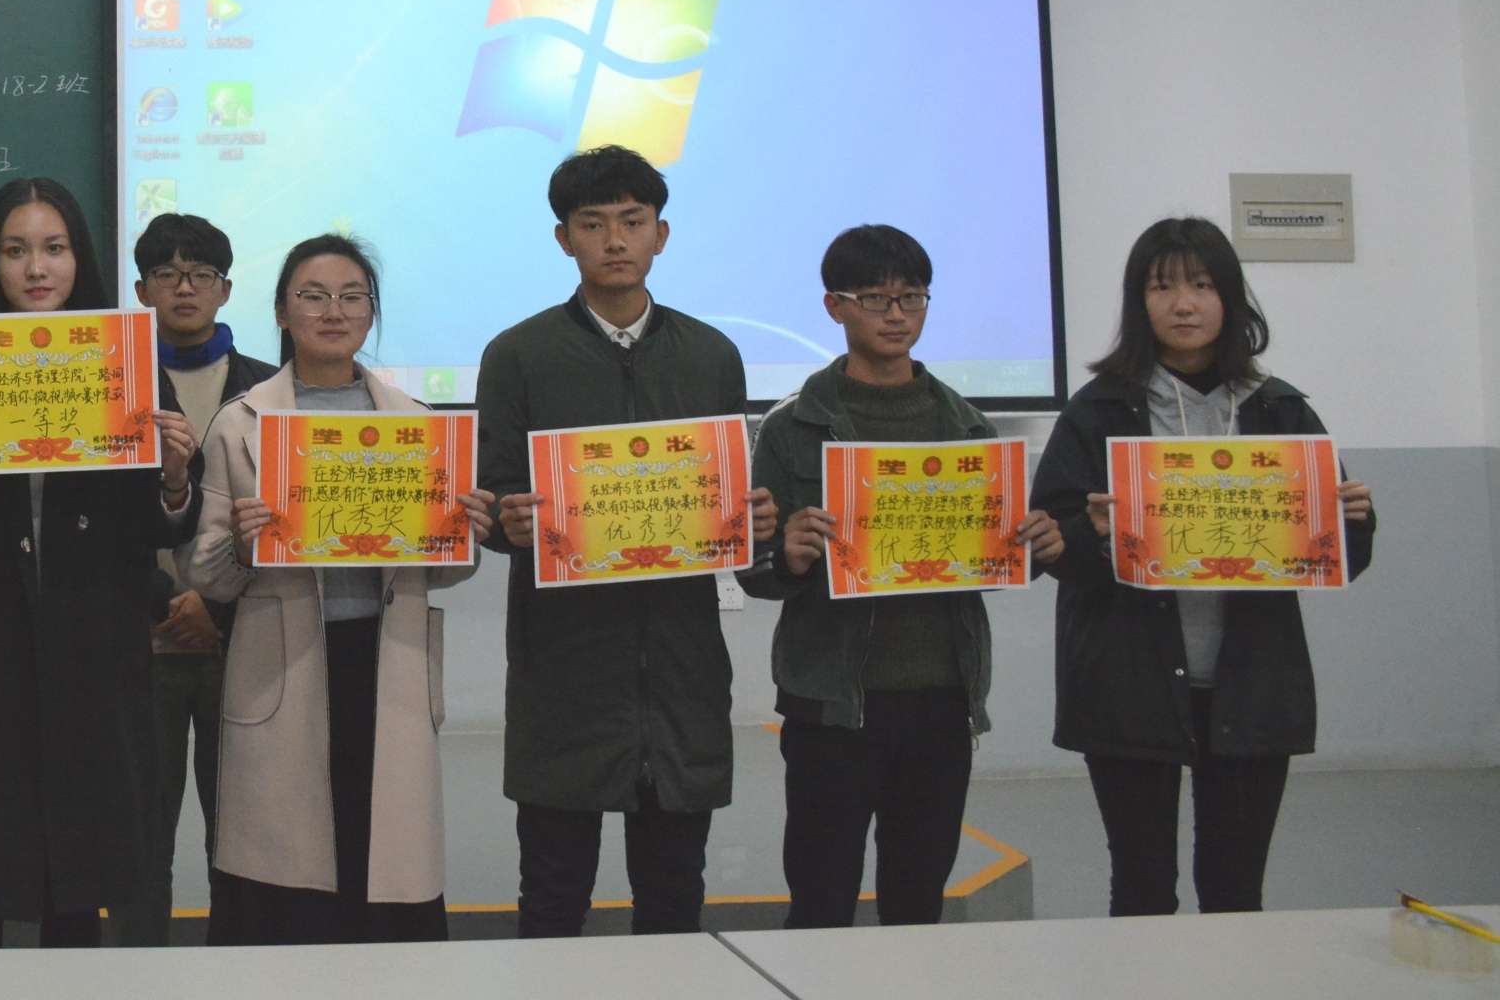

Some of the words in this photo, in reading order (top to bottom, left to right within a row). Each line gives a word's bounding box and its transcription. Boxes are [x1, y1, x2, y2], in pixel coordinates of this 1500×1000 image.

[9, 407, 81, 438] 一等奖
[312, 505, 406, 538] 优秀奖
[605, 513, 686, 544] 优秀奖
[874, 532, 958, 565] 优秀奖
[1164, 523, 1277, 558] 优秀奖
